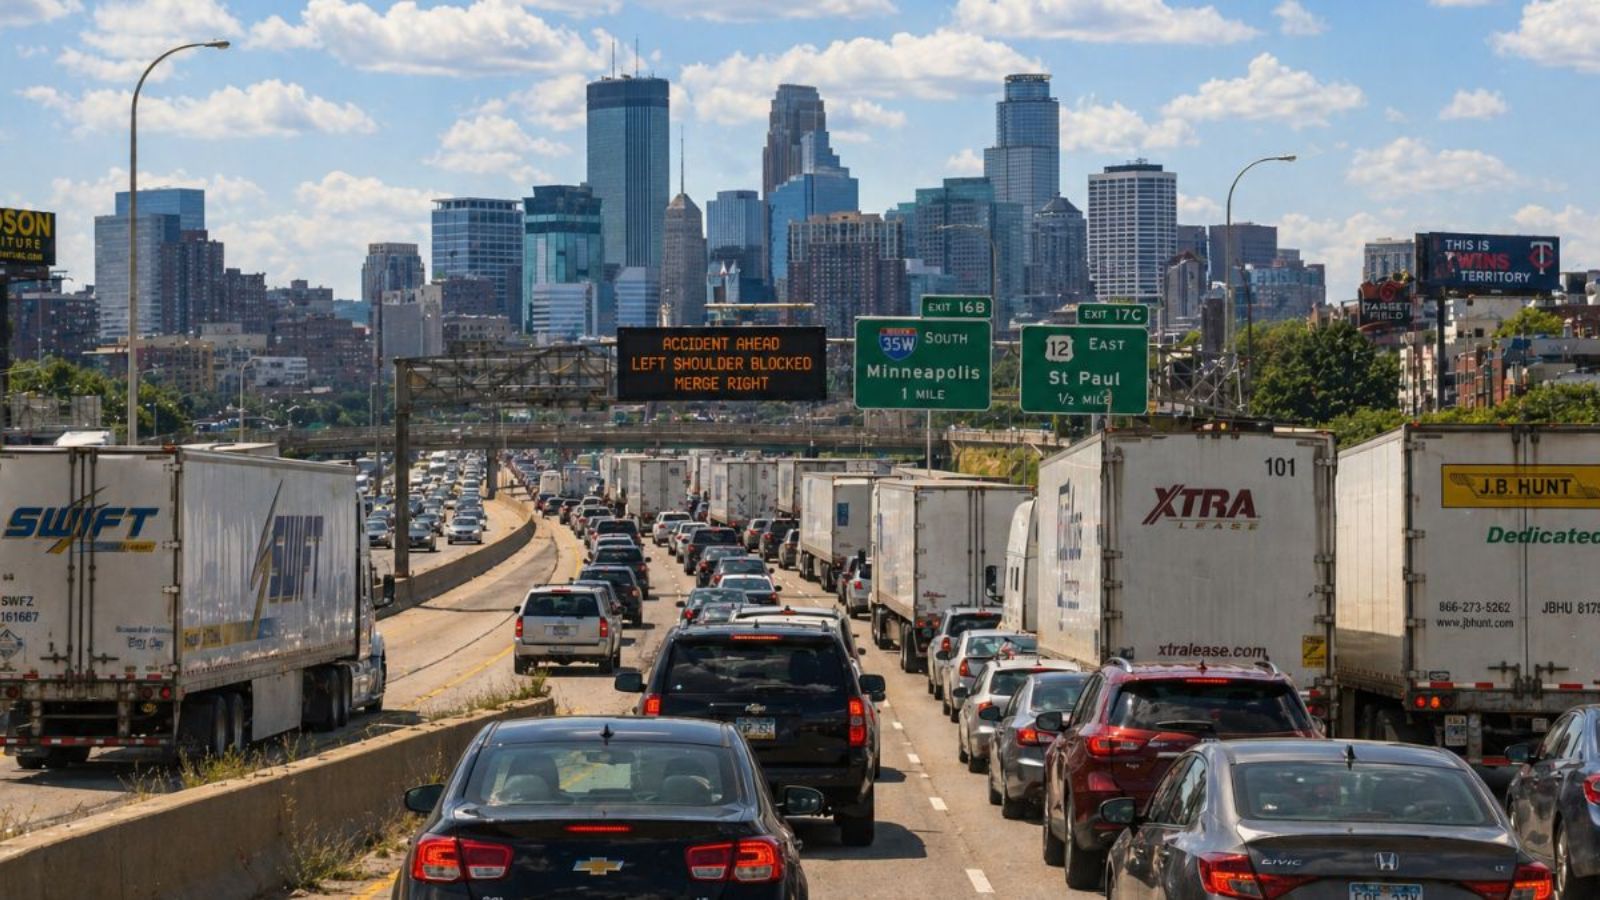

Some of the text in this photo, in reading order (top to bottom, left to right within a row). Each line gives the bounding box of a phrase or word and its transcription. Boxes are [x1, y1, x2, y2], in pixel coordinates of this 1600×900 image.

[0, 209, 51, 237] SON
[1445, 239, 1490, 251] THIS IS
[1445, 251, 1510, 271] TWINS
[1460, 270, 1531, 282] TERRITORY
[928, 302, 985, 313] EXIT 16B
[1084, 309, 1141, 321] EXIT 17C
[663, 337, 780, 350] ACCIDENT AHEAD
[883, 337, 915, 352] 35W
[1051, 341, 1069, 357] 12
[631, 357, 812, 371] LEFT SHOULDER BLOCKED
[866, 364, 980, 382] Minneapolis
[1049, 371, 1120, 386] St Paul
[674, 377, 769, 391] MERGE RIGHT
[902, 387, 945, 401] 1 MILE
[1082, 395, 1112, 406] MILE
[1265, 458, 1295, 477] 101
[1480, 478, 1571, 495] J.B. HUNT
[1142, 484, 1258, 526] XTRA
[3, 506, 161, 539] SWIFT
[1178, 522, 1260, 531] LEASE
[0, 595, 35, 607] SWFZ
[1438, 601, 1511, 613] 866-273-5262
[1541, 602, 1573, 614] JBHU
[1436, 618, 1514, 630] www.jbhunt.com
[1157, 642, 1268, 658] xtralease.com
